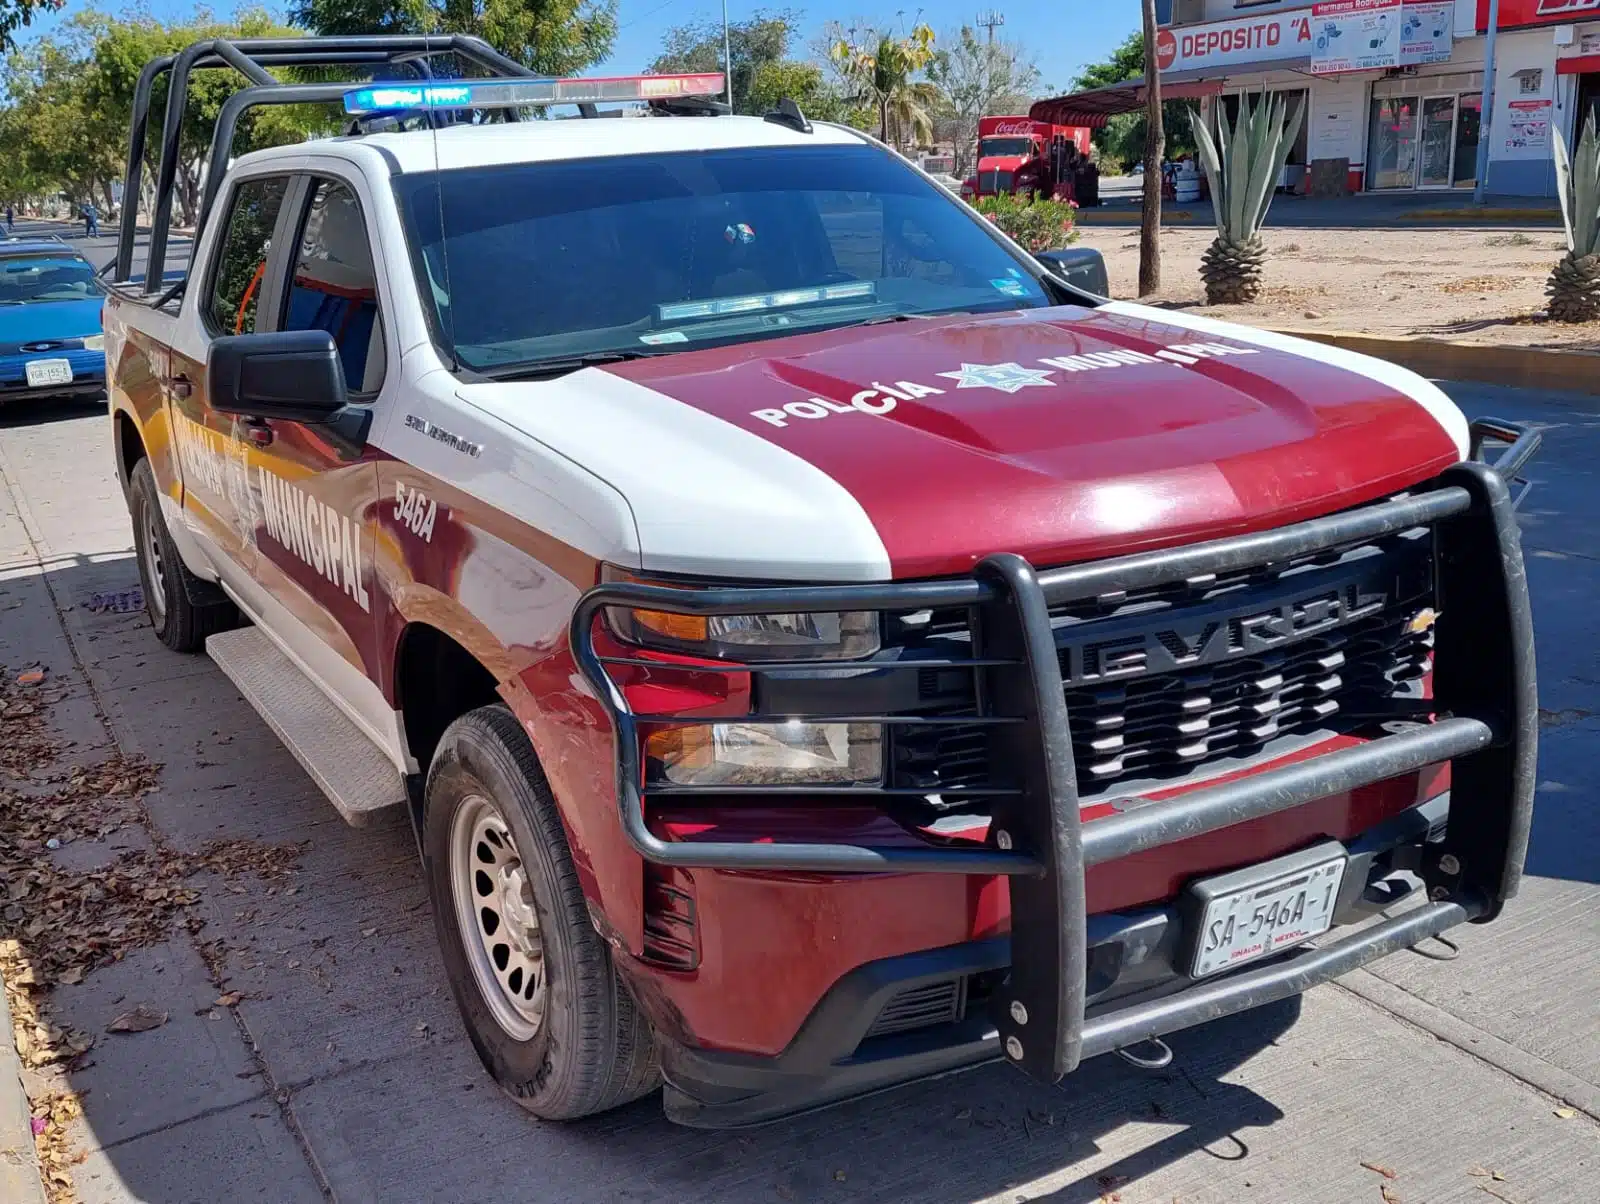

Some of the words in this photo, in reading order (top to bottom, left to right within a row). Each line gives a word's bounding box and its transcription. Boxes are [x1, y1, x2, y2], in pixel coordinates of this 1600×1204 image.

[1182, 23, 1280, 58] DEPOSITO
[750, 381, 946, 427] POLCÍA
[1037, 342, 1261, 372] MUNIIPAL
[258, 465, 370, 614] MUNICIPAL
[393, 480, 437, 544] 546A
